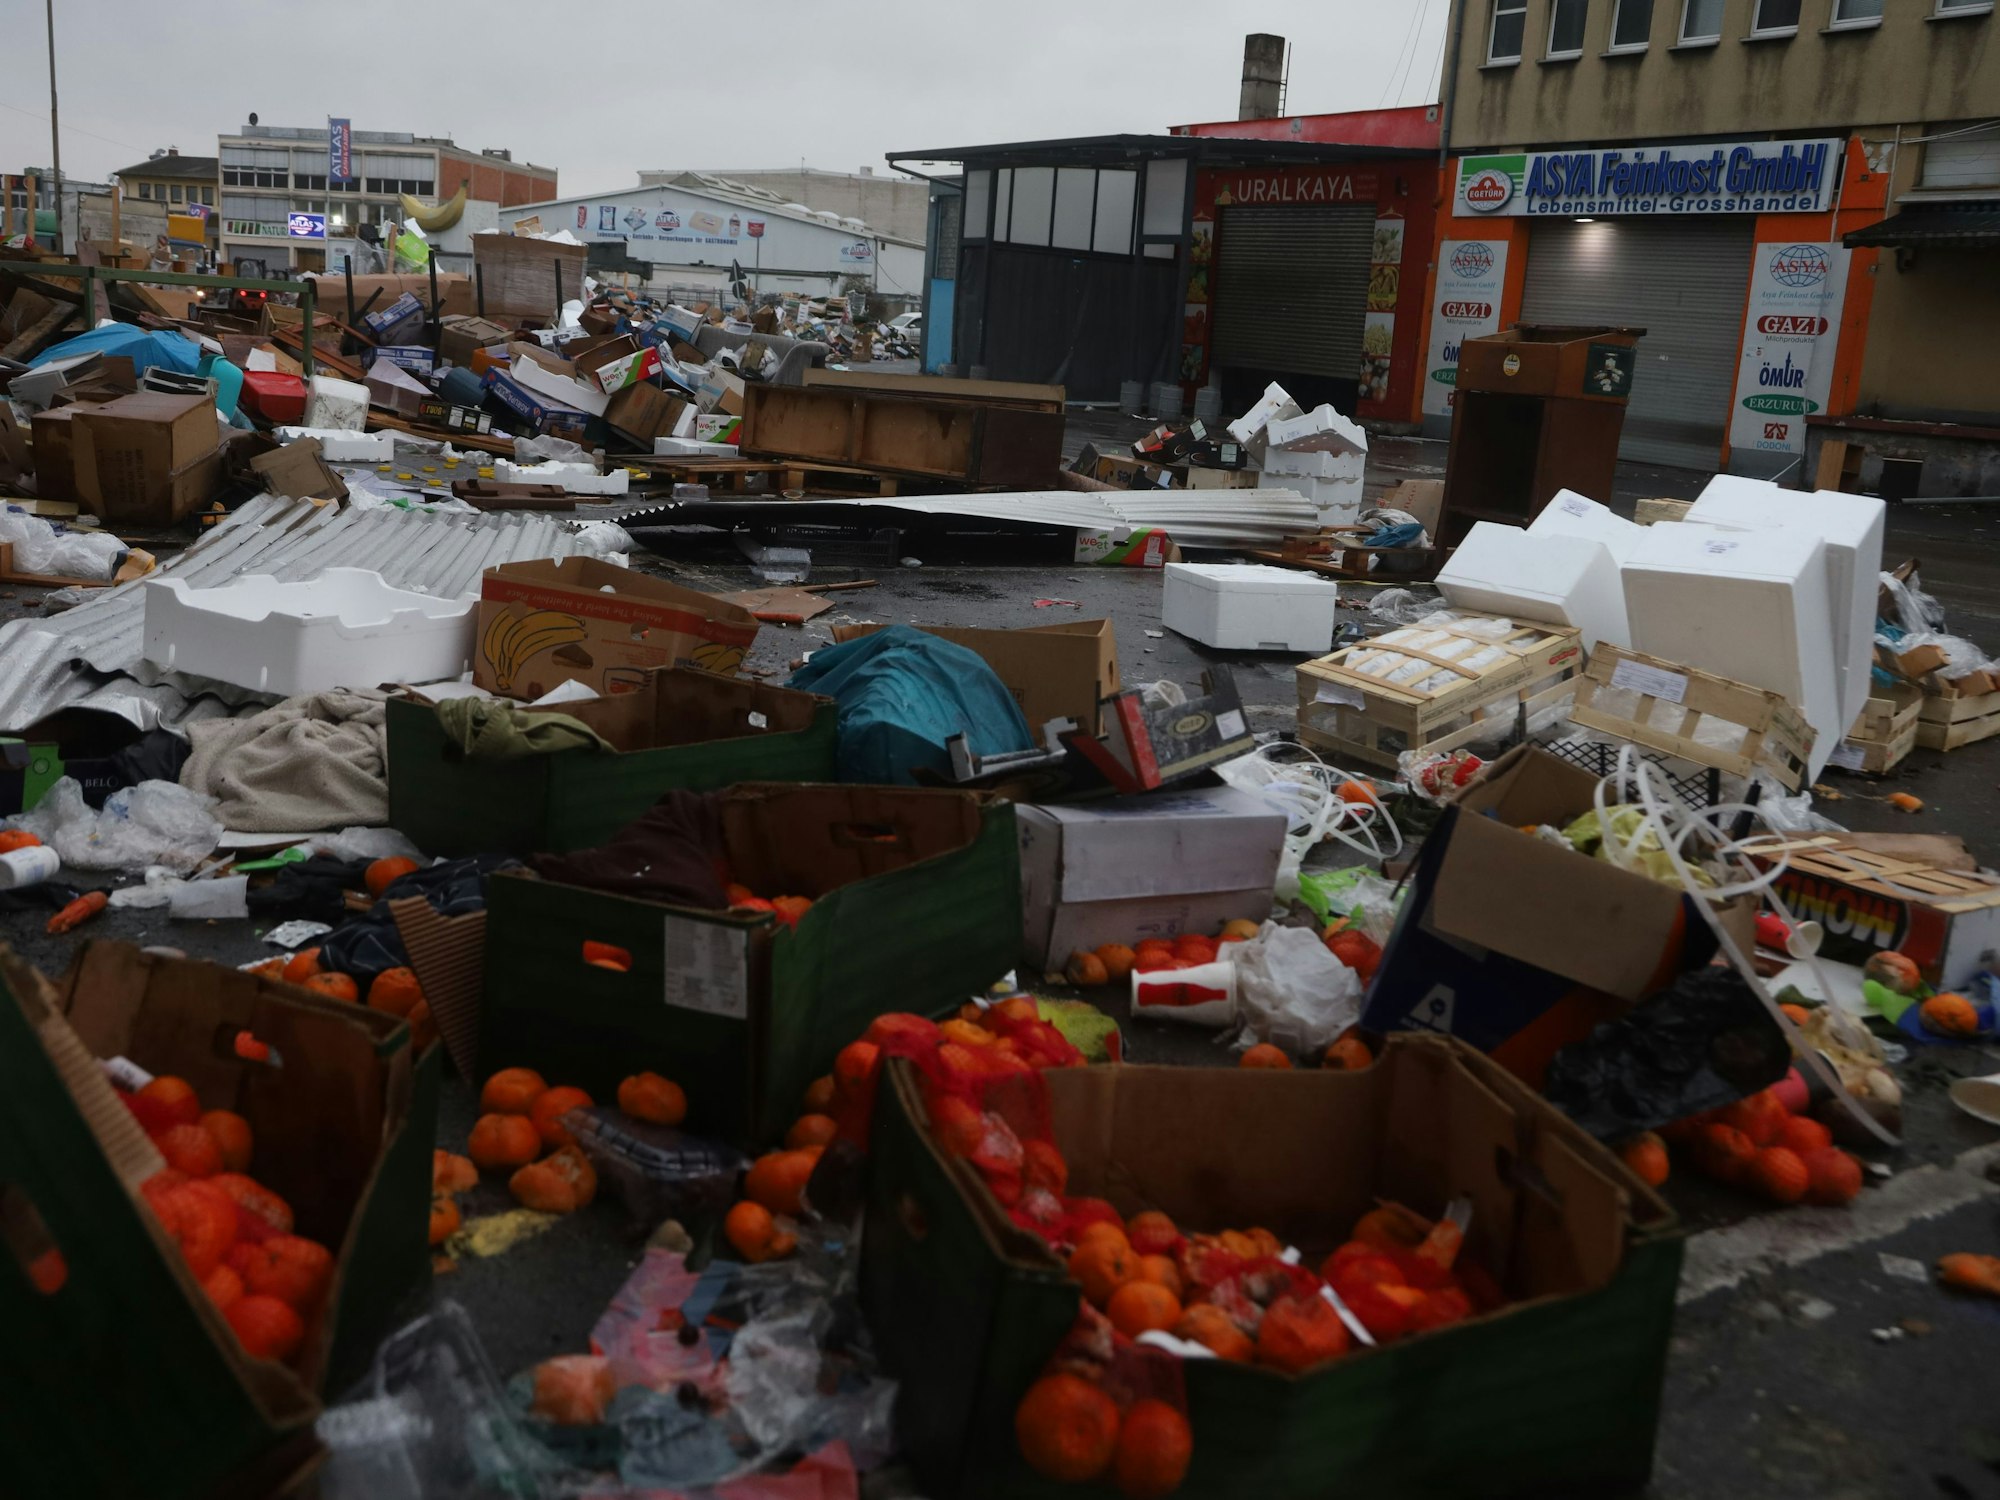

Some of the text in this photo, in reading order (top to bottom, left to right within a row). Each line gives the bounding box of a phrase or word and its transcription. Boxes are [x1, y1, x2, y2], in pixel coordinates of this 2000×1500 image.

[331, 125, 342, 177] ATLAS
[1525, 143, 1828, 198] ASYA Feinkost GmbH
[1238, 175, 1354, 202] URALKAYA
[1469, 188, 1504, 198] EGETÜRK
[1527, 194, 1820, 214] Lebensmittel-Grosshandel
[290, 219, 314, 228] ATLAS
[655, 215, 681, 224] ATLAS
[1452, 255, 1491, 267] ASYA
[1771, 260, 1827, 273] ASYA
[1765, 335, 1815, 344] Milchprodukte
[1749, 398, 1813, 412] ERZURUM
[1756, 441, 1791, 450] DODONI
[506, 589, 529, 600] Place
[585, 604, 610, 614] World
[612, 608, 628, 618] The
